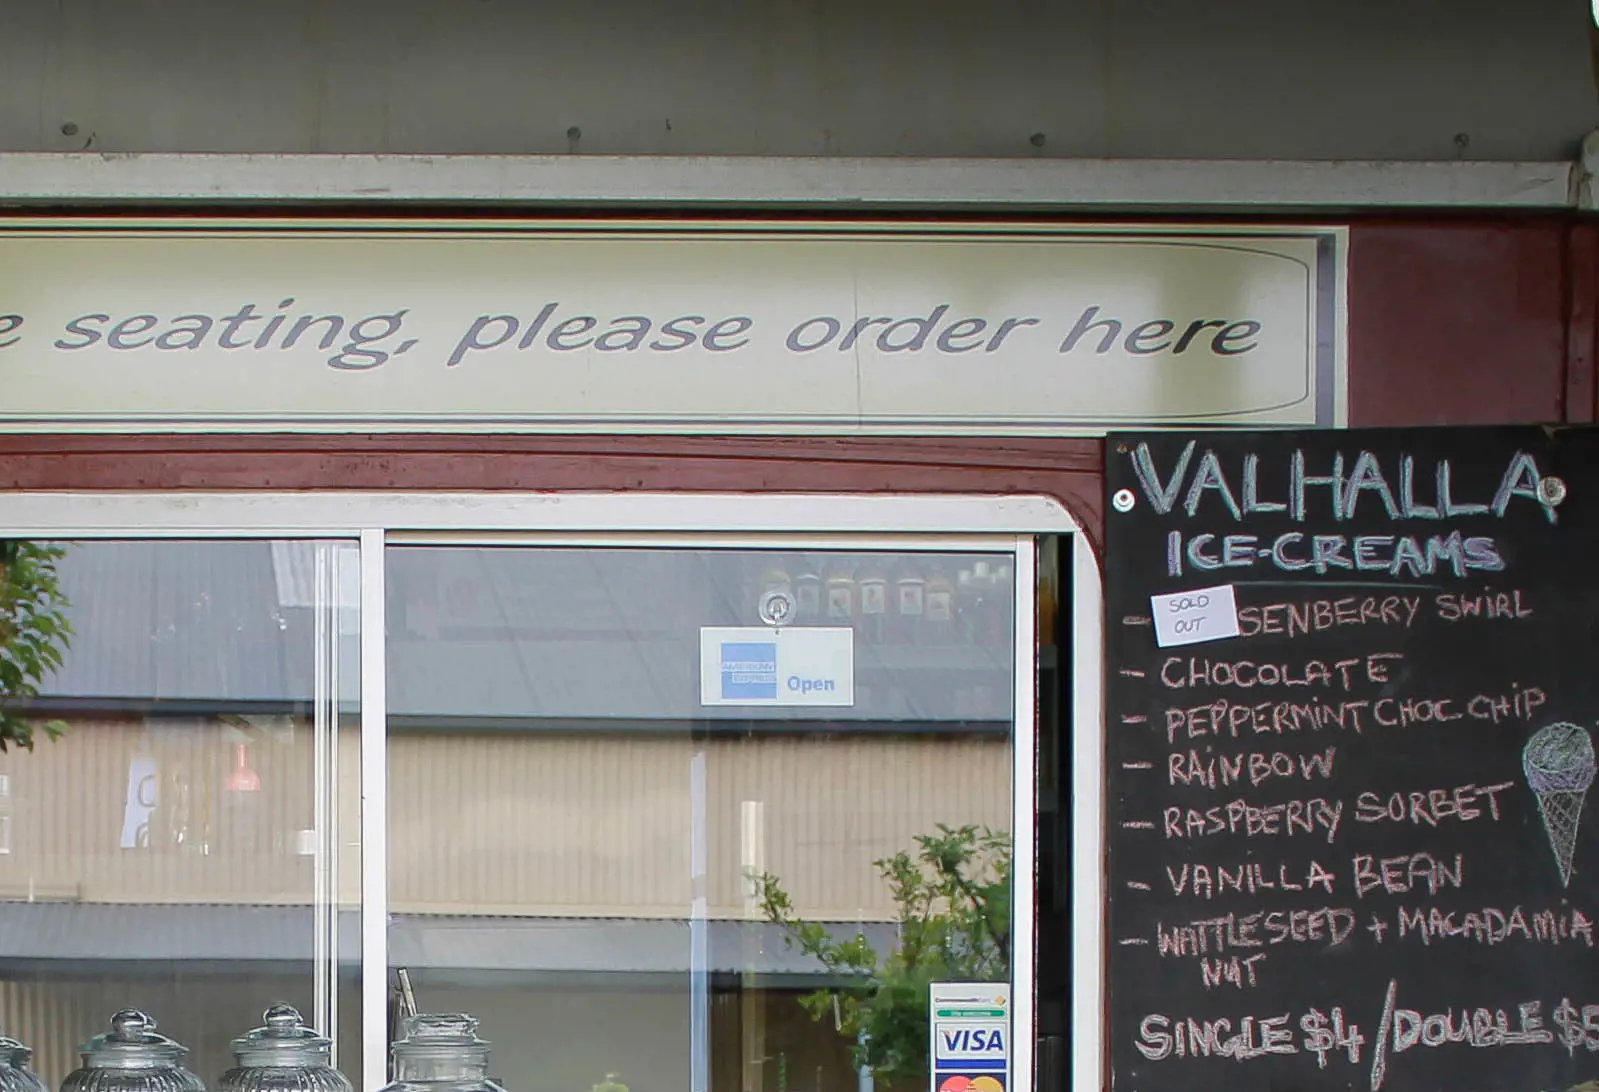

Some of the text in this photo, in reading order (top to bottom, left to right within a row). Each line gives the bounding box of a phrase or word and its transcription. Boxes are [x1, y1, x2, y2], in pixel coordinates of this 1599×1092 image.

[53, 298, 419, 370] seating,
[446, 302, 752, 367] please
[785, 304, 1042, 354] order
[1058, 305, 1263, 357] here
[1131, 440, 1559, 526] VALHALLA
[1167, 530, 1506, 577] ICE-CREAMS
[1169, 595, 1209, 612] SOLD
[1175, 617, 1206, 633] OUT
[1238, 596, 1420, 639] SENBERRY
[787, 676, 835, 693] Open
[1160, 653, 1403, 689] CHOCOLATE
[1374, 697, 1462, 727] CHOC
[1355, 781, 1514, 826] SORBET
[1352, 853, 1463, 897] BEAN
[1157, 907, 1355, 957] WATTLESEED
[1200, 953, 1266, 989] NUT
[941, 1029, 1004, 1051] VISA
[1135, 1013, 1300, 1060] SINGLE
